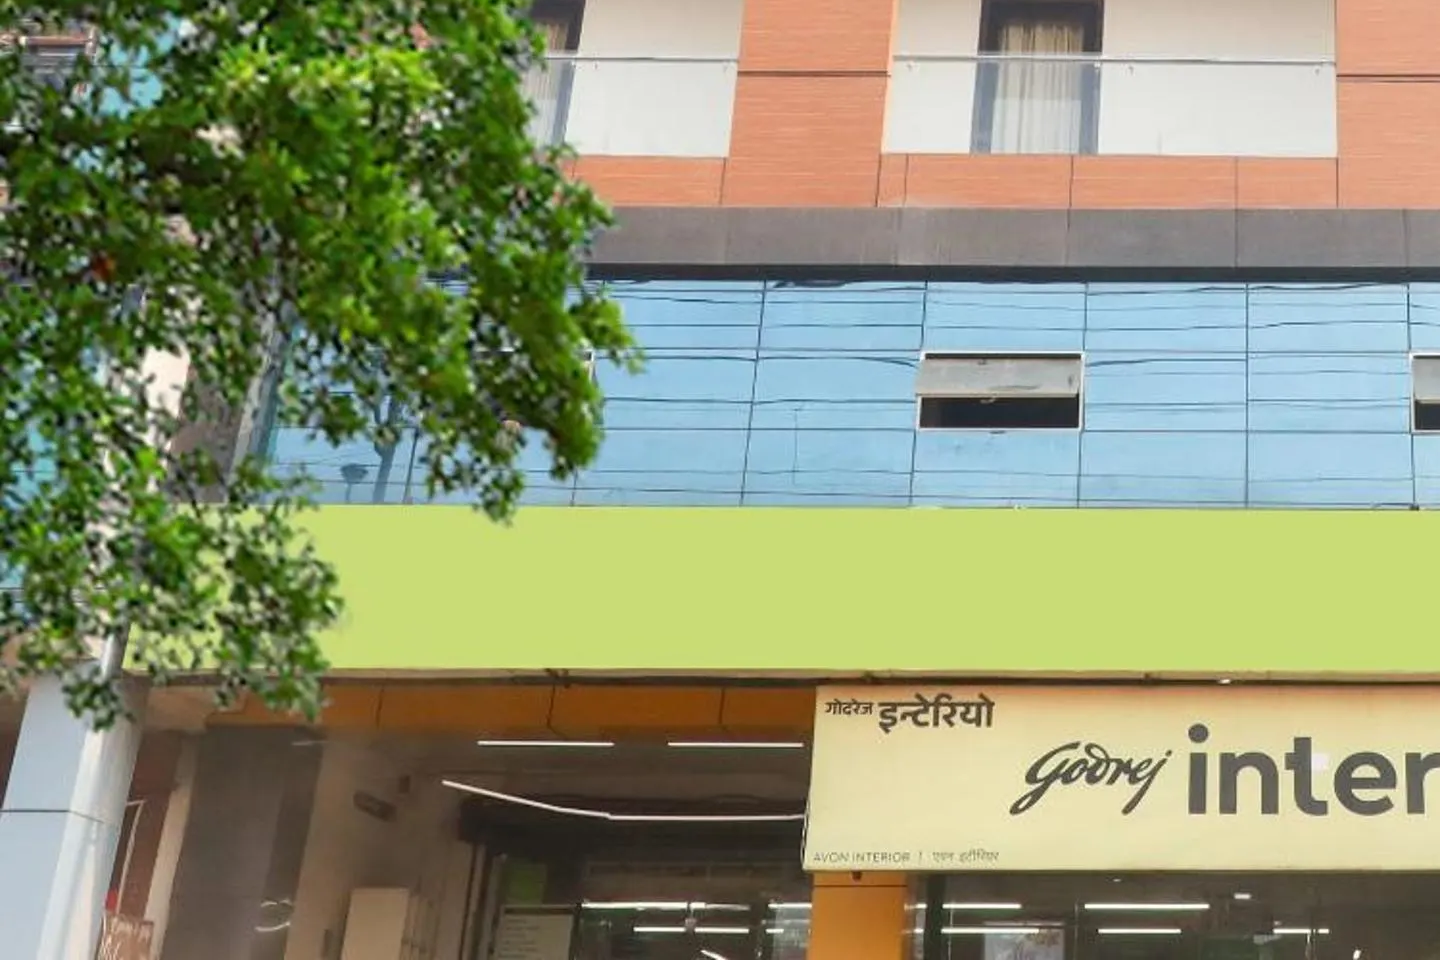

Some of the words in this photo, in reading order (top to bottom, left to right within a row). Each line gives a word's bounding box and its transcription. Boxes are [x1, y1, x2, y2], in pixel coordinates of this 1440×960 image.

[825, 698, 875, 716] गोदरेज
[878, 692, 996, 734] इन्टेरियो
[1009, 741, 1172, 815] Godrej
[813, 851, 849, 863] AVON
[851, 851, 911, 863] INTERIOR
